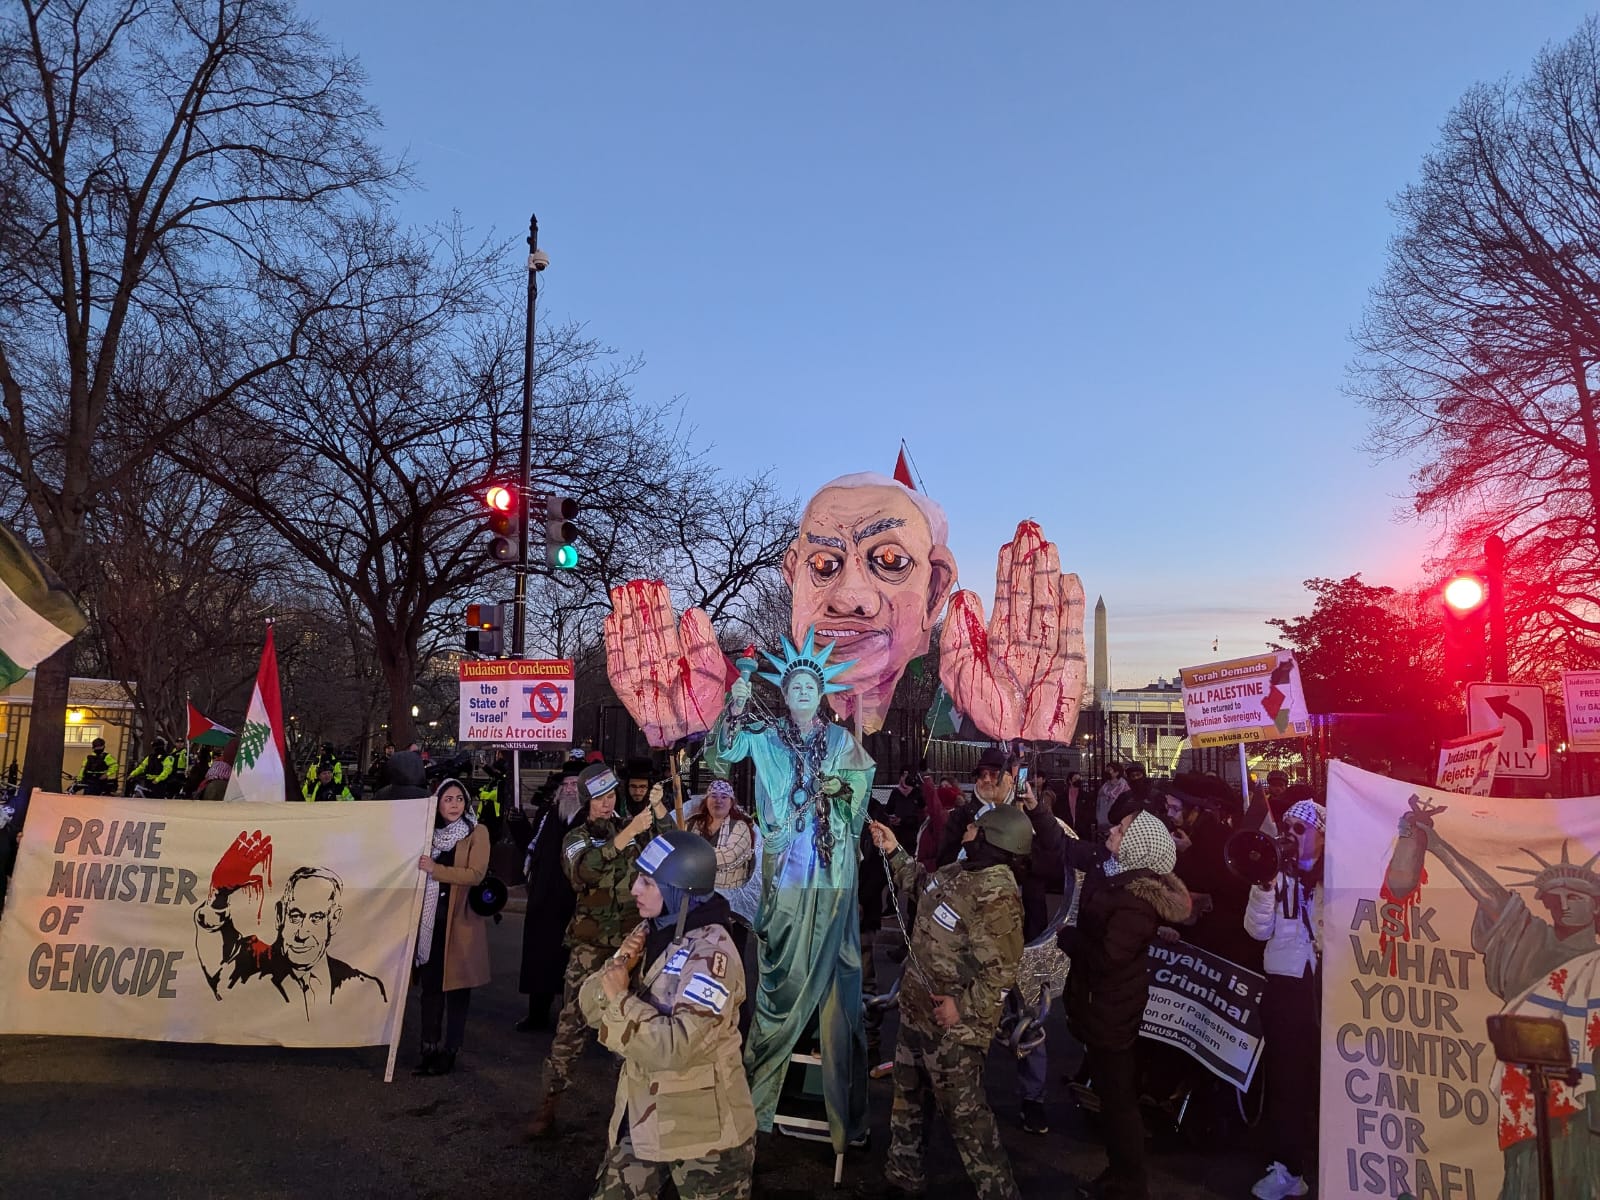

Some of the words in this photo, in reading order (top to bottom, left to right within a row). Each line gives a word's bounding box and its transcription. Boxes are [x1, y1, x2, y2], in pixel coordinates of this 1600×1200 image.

[464, 663, 506, 676] Judaism
[509, 661, 570, 676] Condemns
[1192, 670, 1218, 683] Torah
[1221, 662, 1268, 678] Demands
[470, 698, 496, 709] State
[500, 697, 510, 708] of
[480, 684, 498, 694] the
[1187, 693, 1205, 706] ALL
[1207, 682, 1264, 702] PALESTINE
[1189, 714, 1222, 728] Palestinian
[1223, 710, 1262, 724] Sovereignty
[1202, 706, 1210, 714] be
[1210, 702, 1234, 714] returned
[1234, 702, 1242, 710] to
[468, 726, 488, 738] And
[490, 726, 502, 738] its
[506, 726, 567, 738] Atrocities
[1200, 730, 1260, 744] www.nkusa.org
[1445, 748, 1478, 766] Judaism
[1498, 752, 1536, 768] NLY
[54, 816, 166, 859] PRIME
[46, 861, 198, 905] MINISTER
[39, 906, 84, 935] OF
[1350, 898, 1440, 943] ASK
[28, 942, 184, 999] GENOCIDE
[1349, 934, 1476, 990] WHAT
[1155, 968, 1250, 1025] Criminal
[1228, 975, 1248, 997] is
[1350, 978, 1464, 1034] YOUR
[1144, 1009, 1158, 1018] on
[1161, 1012, 1174, 1022] of
[1174, 1016, 1221, 1050] Judaism
[1174, 1000, 1186, 1010] of
[1187, 1006, 1236, 1043] Palestine
[1238, 1038, 1248, 1050] is
[1336, 1022, 1486, 1083] COUNTRY
[1344, 1068, 1420, 1114] CAN
[1438, 1082, 1489, 1126] DO
[1356, 1108, 1430, 1154] FOR
